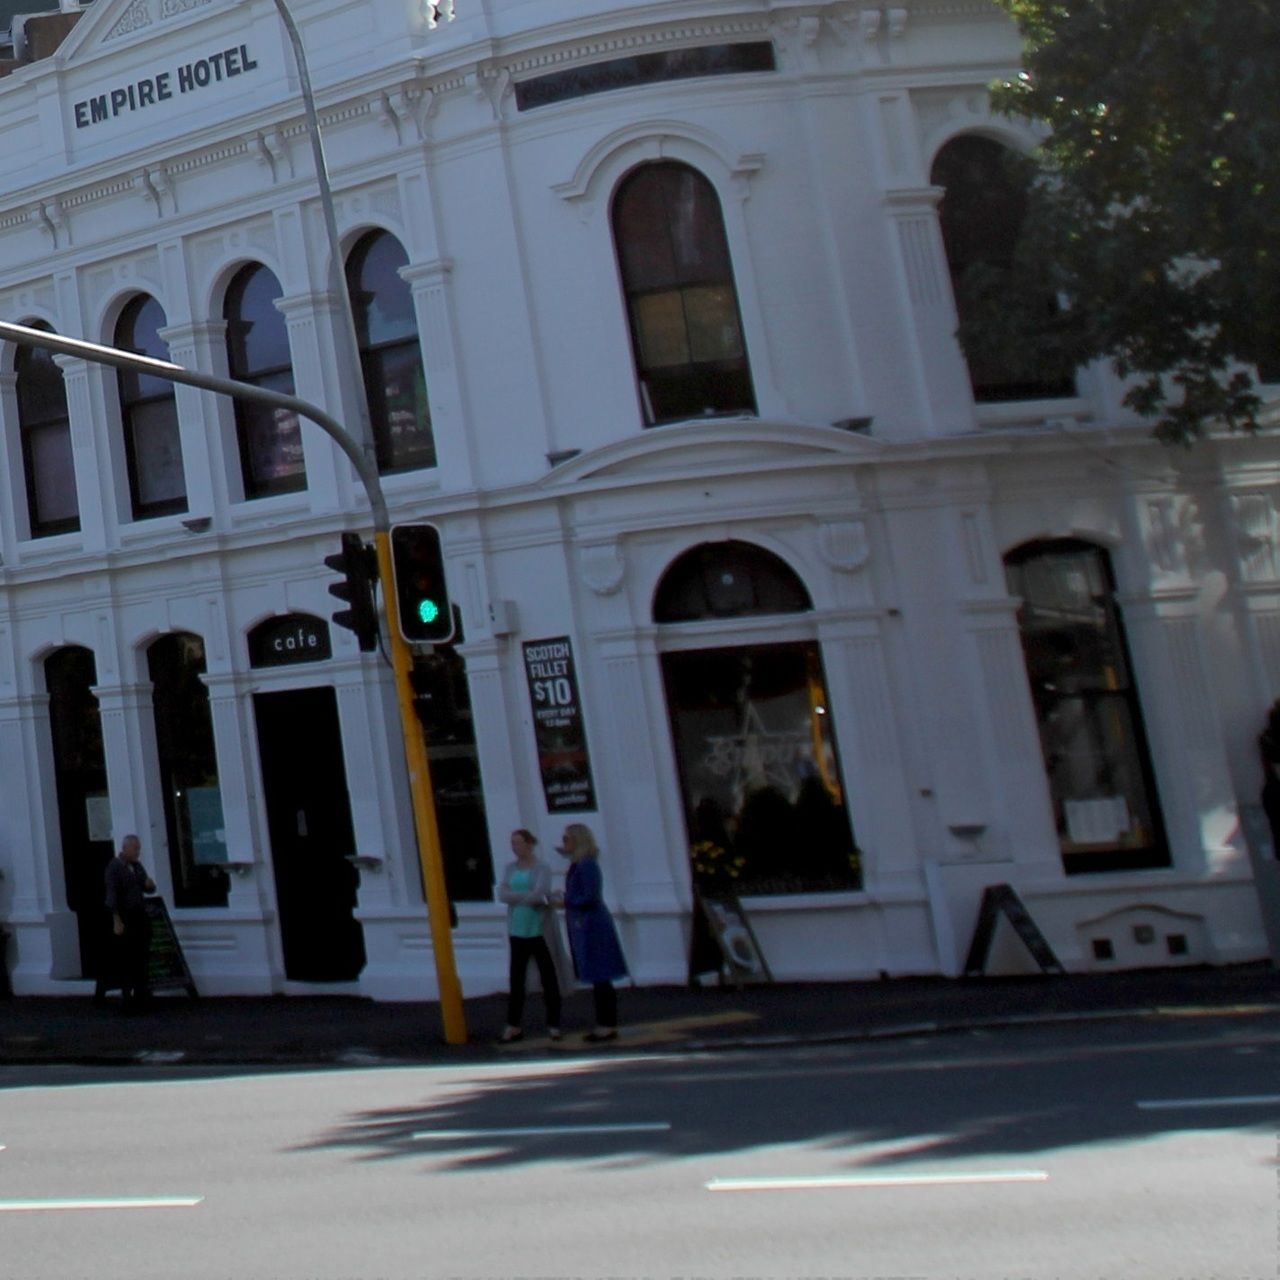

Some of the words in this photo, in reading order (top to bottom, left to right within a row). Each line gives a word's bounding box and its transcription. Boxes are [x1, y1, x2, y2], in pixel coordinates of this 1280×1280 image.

[74, 71, 173, 129] EMPIRE
[177, 44, 258, 94] HOTEL
[274, 628, 317, 651] cafe
[526, 642, 570, 662] SCOTCH
[530, 660, 568, 678] FILLET
[534, 678, 572, 705] $10
